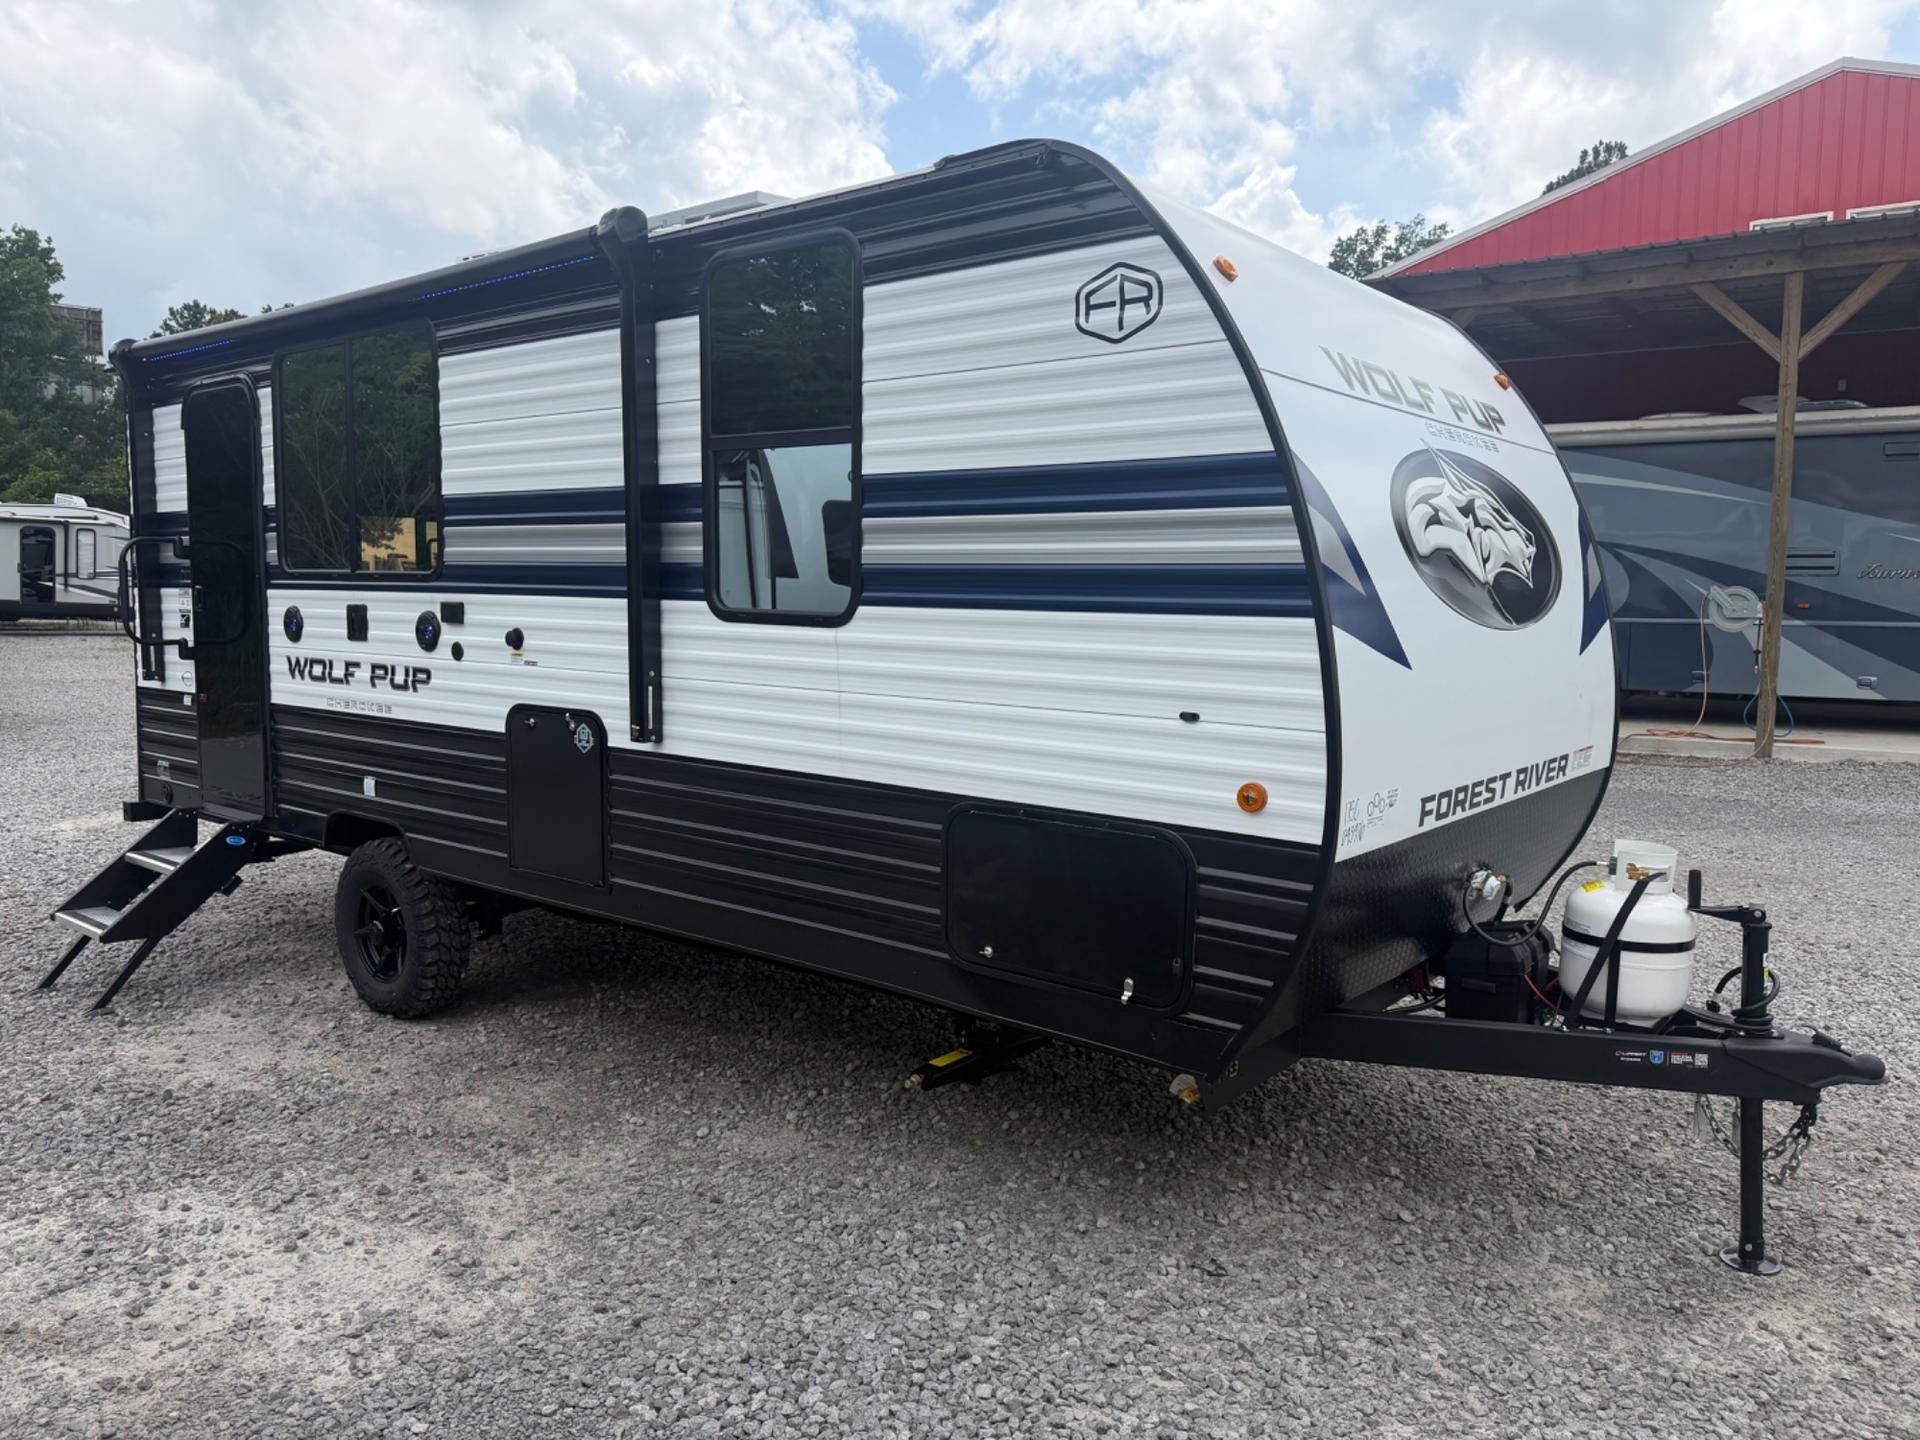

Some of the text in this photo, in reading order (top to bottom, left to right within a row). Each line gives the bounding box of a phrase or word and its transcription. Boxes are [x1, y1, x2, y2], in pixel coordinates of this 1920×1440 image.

[1318, 345, 1506, 435] WOLF PUP
[286, 655, 432, 693] WOLF PUP
[326, 697, 393, 714] CHEROKEE
[1418, 771, 1512, 827] FOREST
[1513, 753, 1570, 795] RIVER
